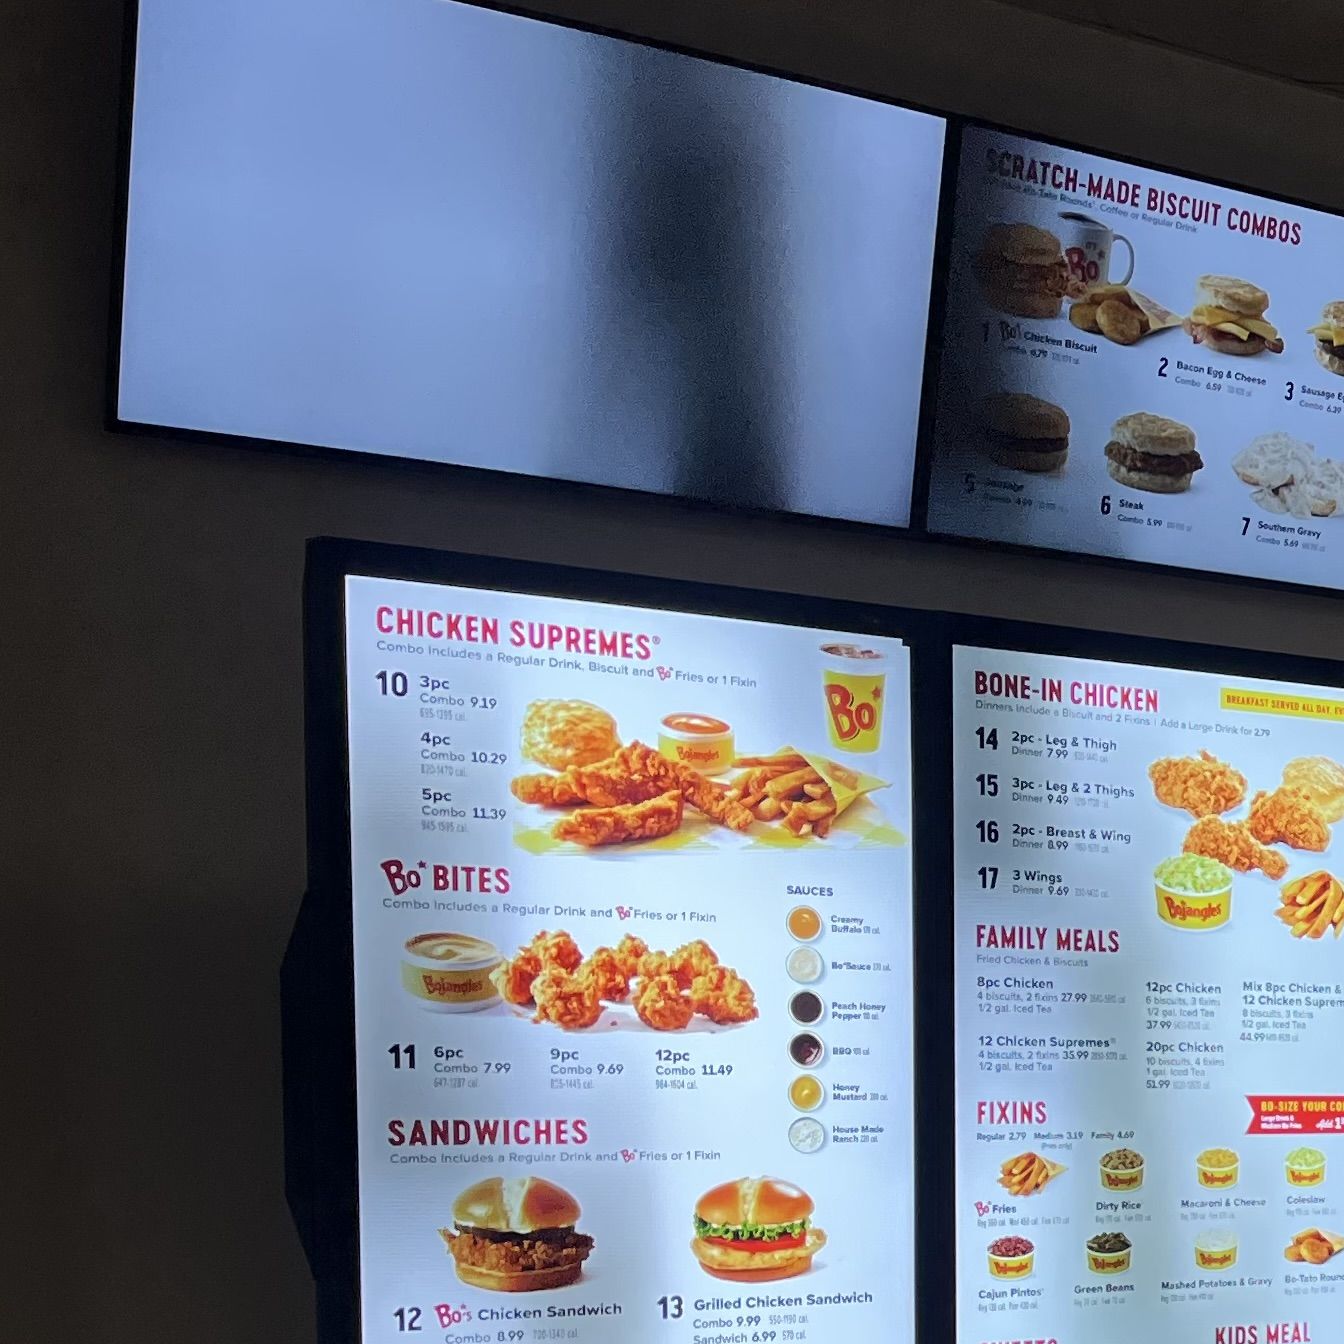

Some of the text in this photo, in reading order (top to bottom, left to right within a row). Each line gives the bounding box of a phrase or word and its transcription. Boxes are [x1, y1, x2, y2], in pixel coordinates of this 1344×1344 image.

[1147, 187, 1222, 226] BISCUIT
[1227, 208, 1301, 246] COMBOS
[1158, 357, 1169, 377] 2
[1176, 361, 1266, 385] Bacon Egg Cheese
[1284, 381, 1294, 401] 3
[1301, 386, 1335, 400] Sausage
[1100, 495, 1111, 516] 6
[1241, 517, 1250, 535] 7
[1297, 529, 1321, 539] Gravy
[376, 606, 499, 644] CHICKEN
[376, 641, 654, 677] Combo Includes Regular Drink, Biscuit and
[375, 670, 408, 697] 10
[419, 676, 450, 690] 3pc
[975, 671, 1158, 713] BONE-IN CHICKEN
[420, 693, 497, 709] Combo 9.19
[1226, 695, 1269, 707] BREAKFAST
[1271, 700, 1299, 711] SERVED
[1302, 703, 1314, 712] ALL
[420, 732, 451, 746] 4pc
[975, 727, 998, 750] 14
[421, 749, 507, 764] Combo 10.29
[421, 788, 451, 802] 5pc
[976, 774, 998, 796] 15
[421, 805, 506, 820] Combo 11.39
[976, 820, 999, 843] 16
[433, 865, 511, 894] BITES
[978, 867, 998, 889] 17
[1013, 870, 1062, 884] 3 Wings
[786, 885, 833, 896] SAUCES
[1164, 897, 1221, 920] Bojangles
[977, 925, 1120, 952] FAMILY MEALS
[388, 1044, 415, 1069] 11
[434, 1046, 464, 1059] 6pc
[550, 1048, 579, 1061] 9pc
[655, 1050, 690, 1062] 12pc
[434, 1062, 511, 1073] Combo 7.99
[550, 1063, 624, 1075] Combo 9.69
[656, 1065, 733, 1076] Combo 11.49
[977, 1101, 1047, 1125] FIXINS
[388, 1119, 588, 1146] SANDWICHES
[657, 1292, 872, 1320] 13 Grilled Chicken Sandwich
[394, 1307, 422, 1332] 12
[478, 1308, 542, 1321] Chicken
[547, 1303, 622, 1318] Sandwich
[693, 1315, 761, 1329] Combo 9.99
[445, 1331, 524, 1344] Combo 8.99
[693, 1331, 777, 1344] Sandwich 6.99
[1266, 1322, 1311, 1344] MEAL
